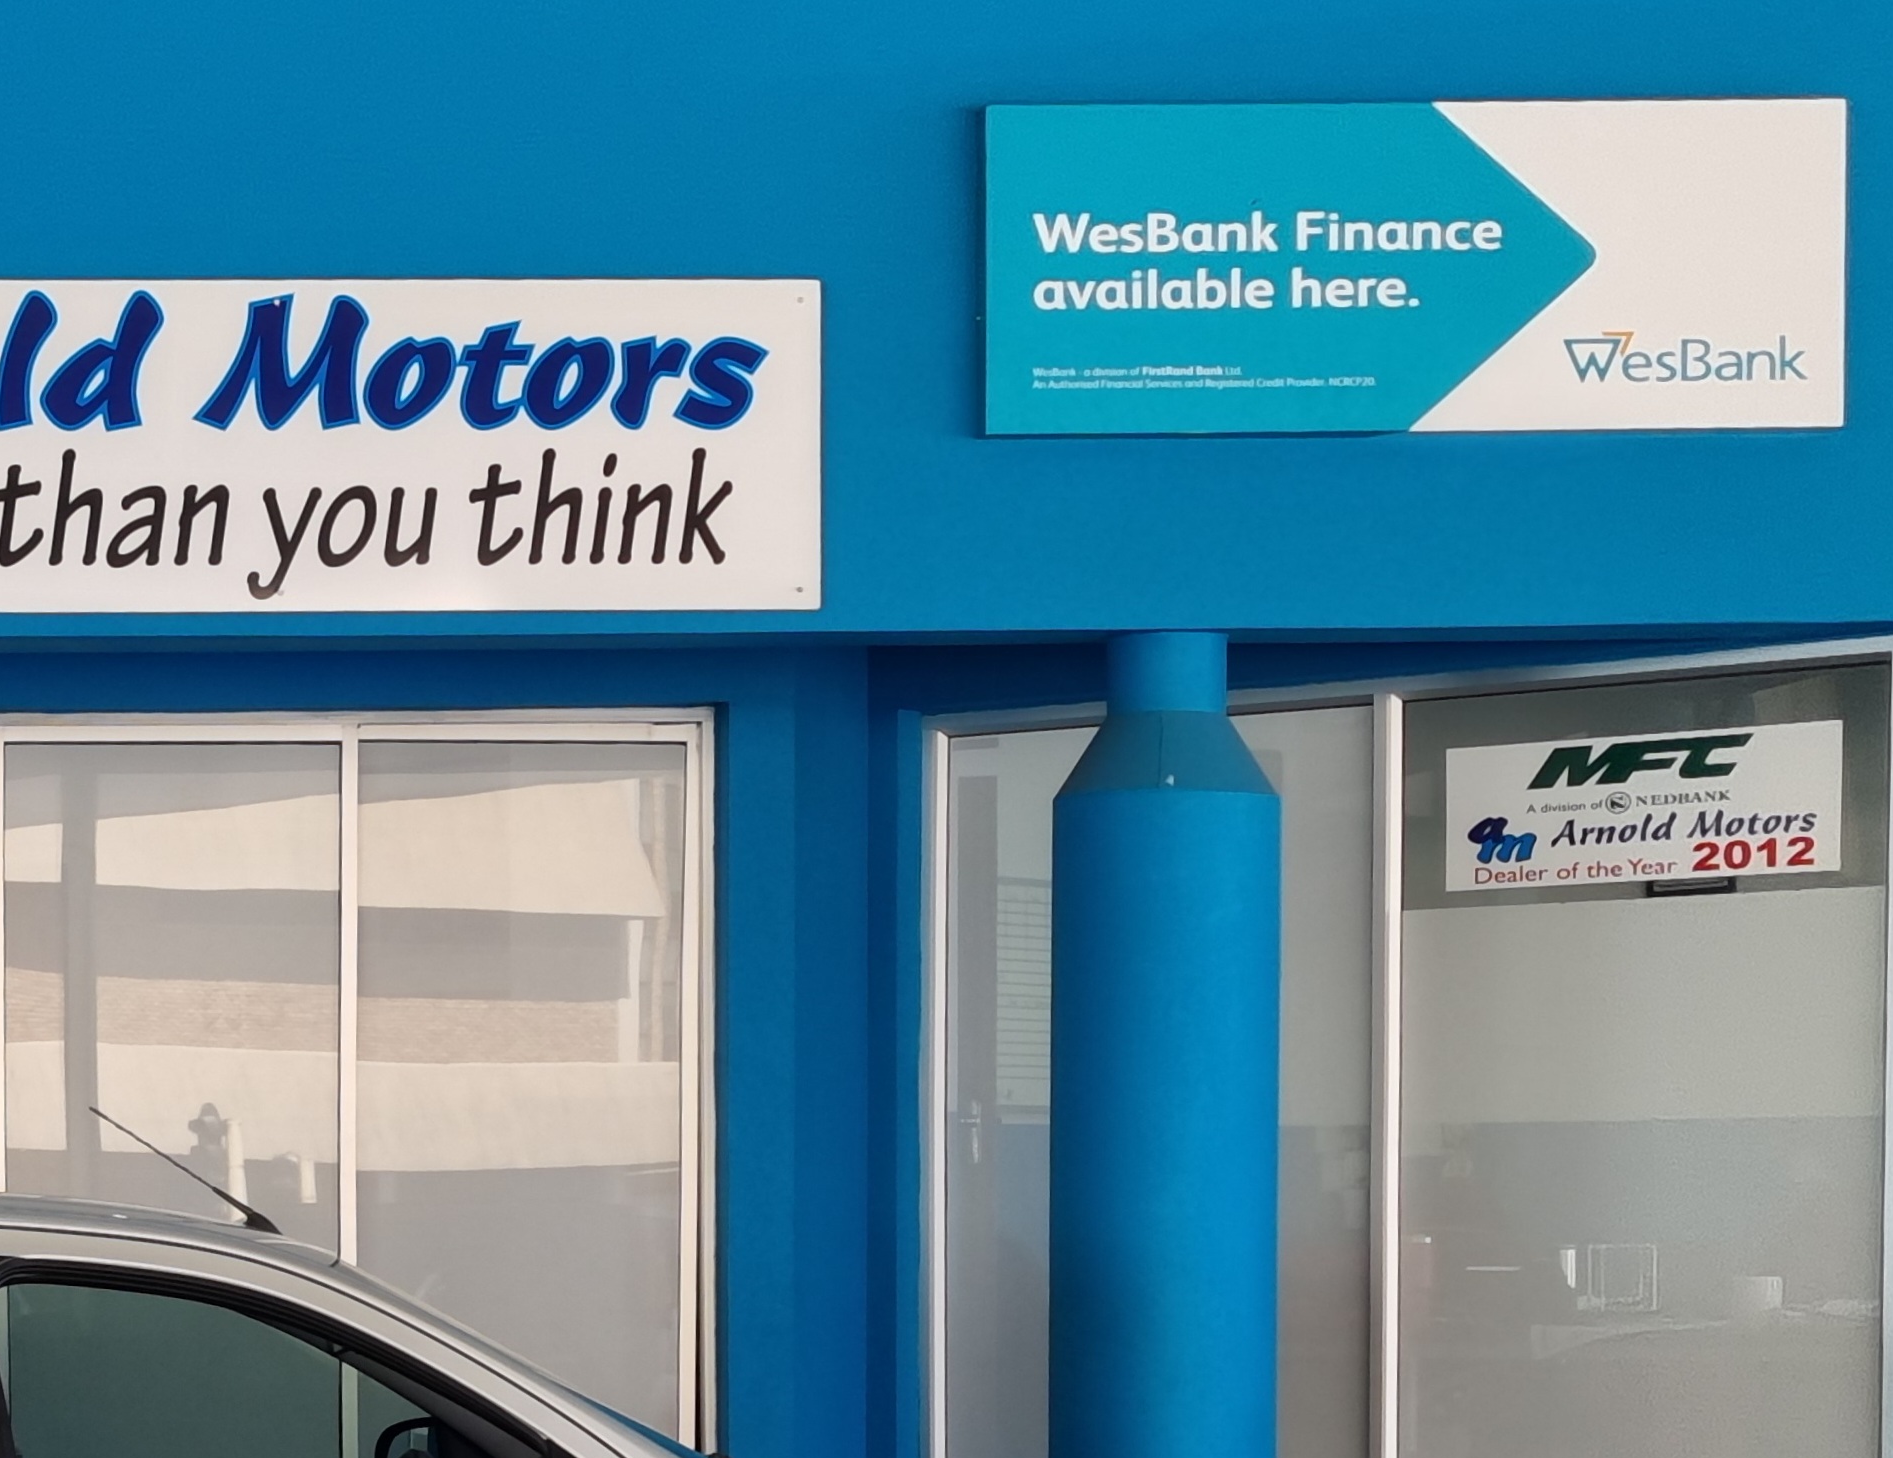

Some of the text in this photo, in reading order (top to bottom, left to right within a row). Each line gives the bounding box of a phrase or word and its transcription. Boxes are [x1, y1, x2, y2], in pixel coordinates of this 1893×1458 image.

[1033, 211, 1503, 253] WesBank Finance
[1033, 267, 1420, 310] available here.
[192, 293, 770, 431] Motors
[1032, 367, 1076, 377] WesBank
[1092, 367, 1127, 377] division
[1129, 367, 1139, 376] of
[1142, 366, 1194, 376] FirstRand
[1196, 365, 1223, 375] Bank
[1563, 331, 1807, 384] WesBank
[1032, 379, 1046, 389] An
[1101, 379, 1143, 388] Financial
[1145, 379, 1183, 388] Services
[1184, 379, 1204, 388] and
[1205, 378, 1254, 389] Registered
[1256, 377, 1284, 387] Credit
[247, 485, 438, 600] you
[469, 448, 733, 566] think
[1527, 732, 1754, 790] MFC
[1527, 789, 1731, 814] A division of NEDBANK
[1551, 809, 1817, 847] Arnold Motors
[1474, 836, 1815, 885] Dealer of the Year 2012
